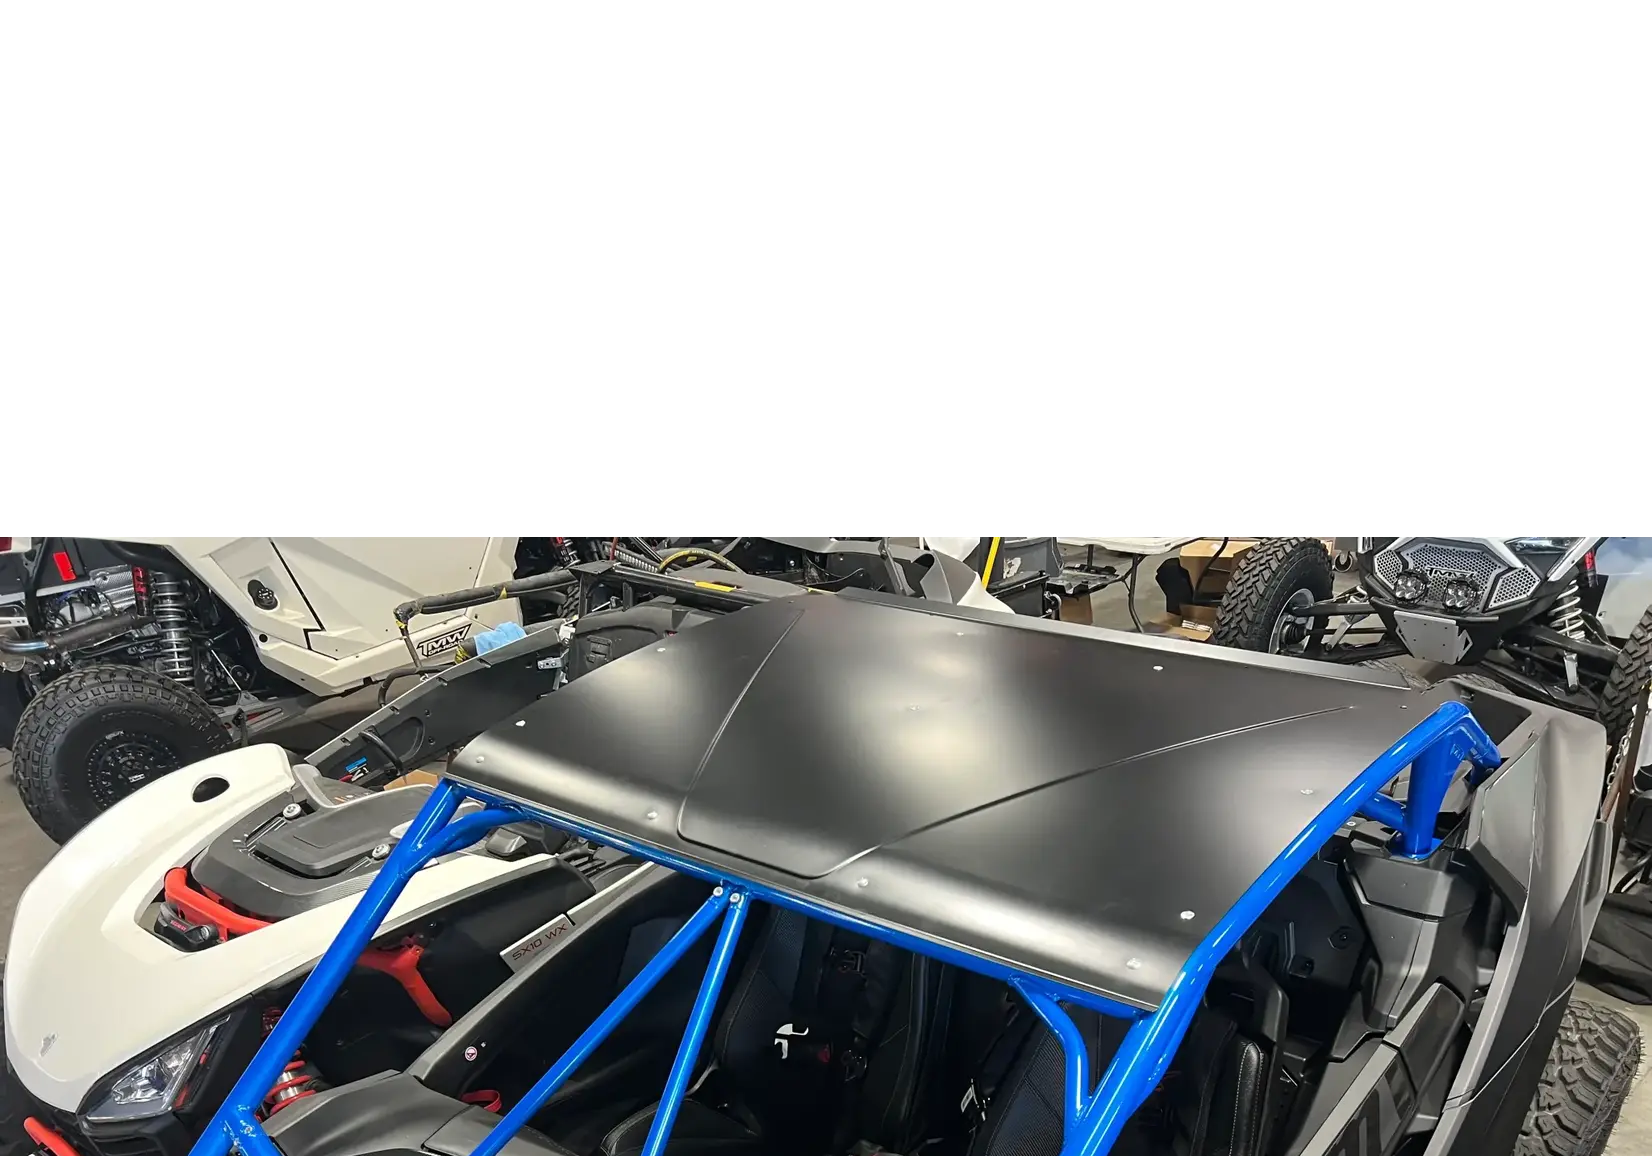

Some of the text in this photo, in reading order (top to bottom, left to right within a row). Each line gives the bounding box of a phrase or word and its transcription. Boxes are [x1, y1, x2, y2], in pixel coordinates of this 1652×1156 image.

[418, 624, 471, 657] TMW
[512, 924, 567, 961] SX10 WX
